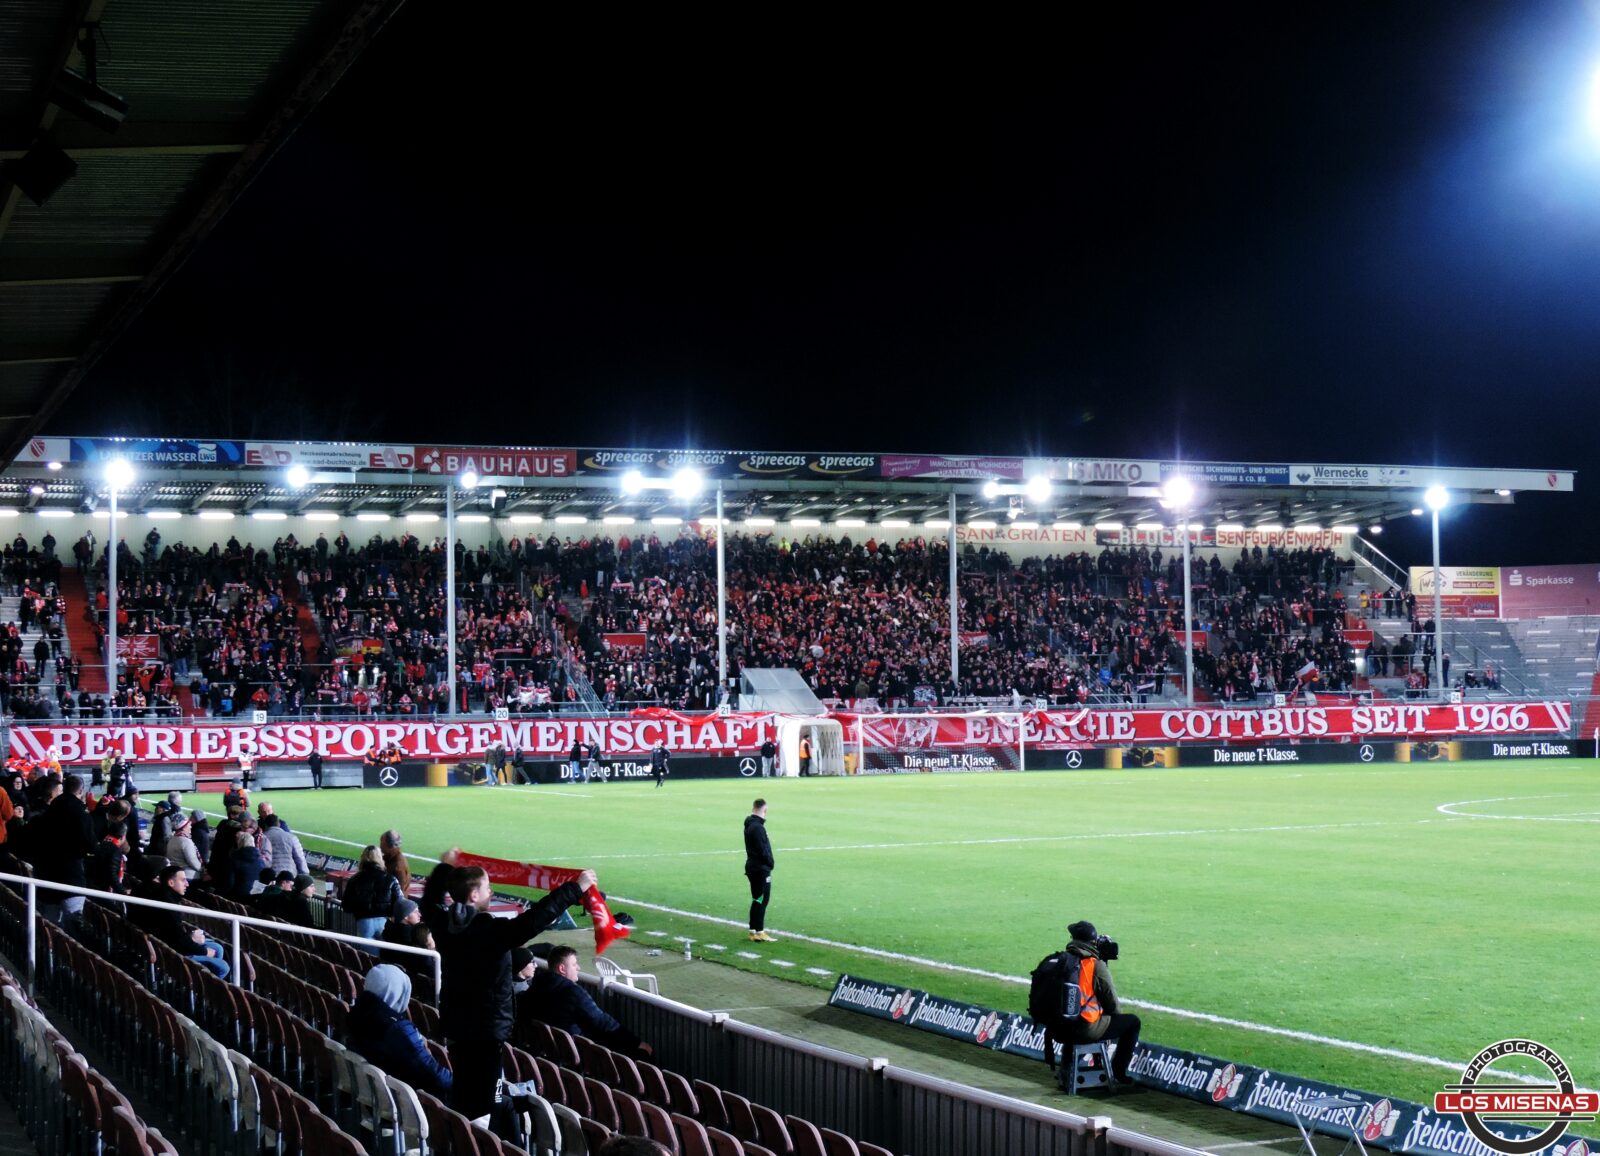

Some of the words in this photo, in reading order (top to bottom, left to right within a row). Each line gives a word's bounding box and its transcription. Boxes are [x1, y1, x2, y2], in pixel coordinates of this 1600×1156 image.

[155, 452, 197, 462] WASSER
[446, 453, 567, 474] BAUHAUS
[1313, 466, 1368, 478] Wernecke
[1120, 527, 1185, 545] BLOCK
[1526, 575, 1574, 587] Sparkasse
[1276, 696, 1285, 704] 23
[1451, 693, 1460, 702] 24
[720, 706, 729, 715] 21
[1037, 701, 1046, 710] 22
[256, 712, 265, 722] 19
[497, 709, 508, 719] 20
[1161, 708, 1328, 738] COTTBUS
[1352, 705, 1430, 734] SEIT
[1453, 703, 1530, 731] 1966
[50, 715, 776, 761] BETRIEBSSPORTGEMEINSCHAFT
[1213, 749, 1230, 762] Die
[1232, 751, 1256, 762] neue
[1256, 748, 1299, 761] T-Klasse.
[1493, 743, 1508, 756] Die
[1509, 745, 1531, 756] neue
[1532, 742, 1570, 756] T-Klasse.
[904, 755, 922, 768] Die
[924, 756, 950, 767] neue
[951, 754, 997, 767] T-Klasse.
[1128, 1042, 1208, 1090] eldschlößchen
